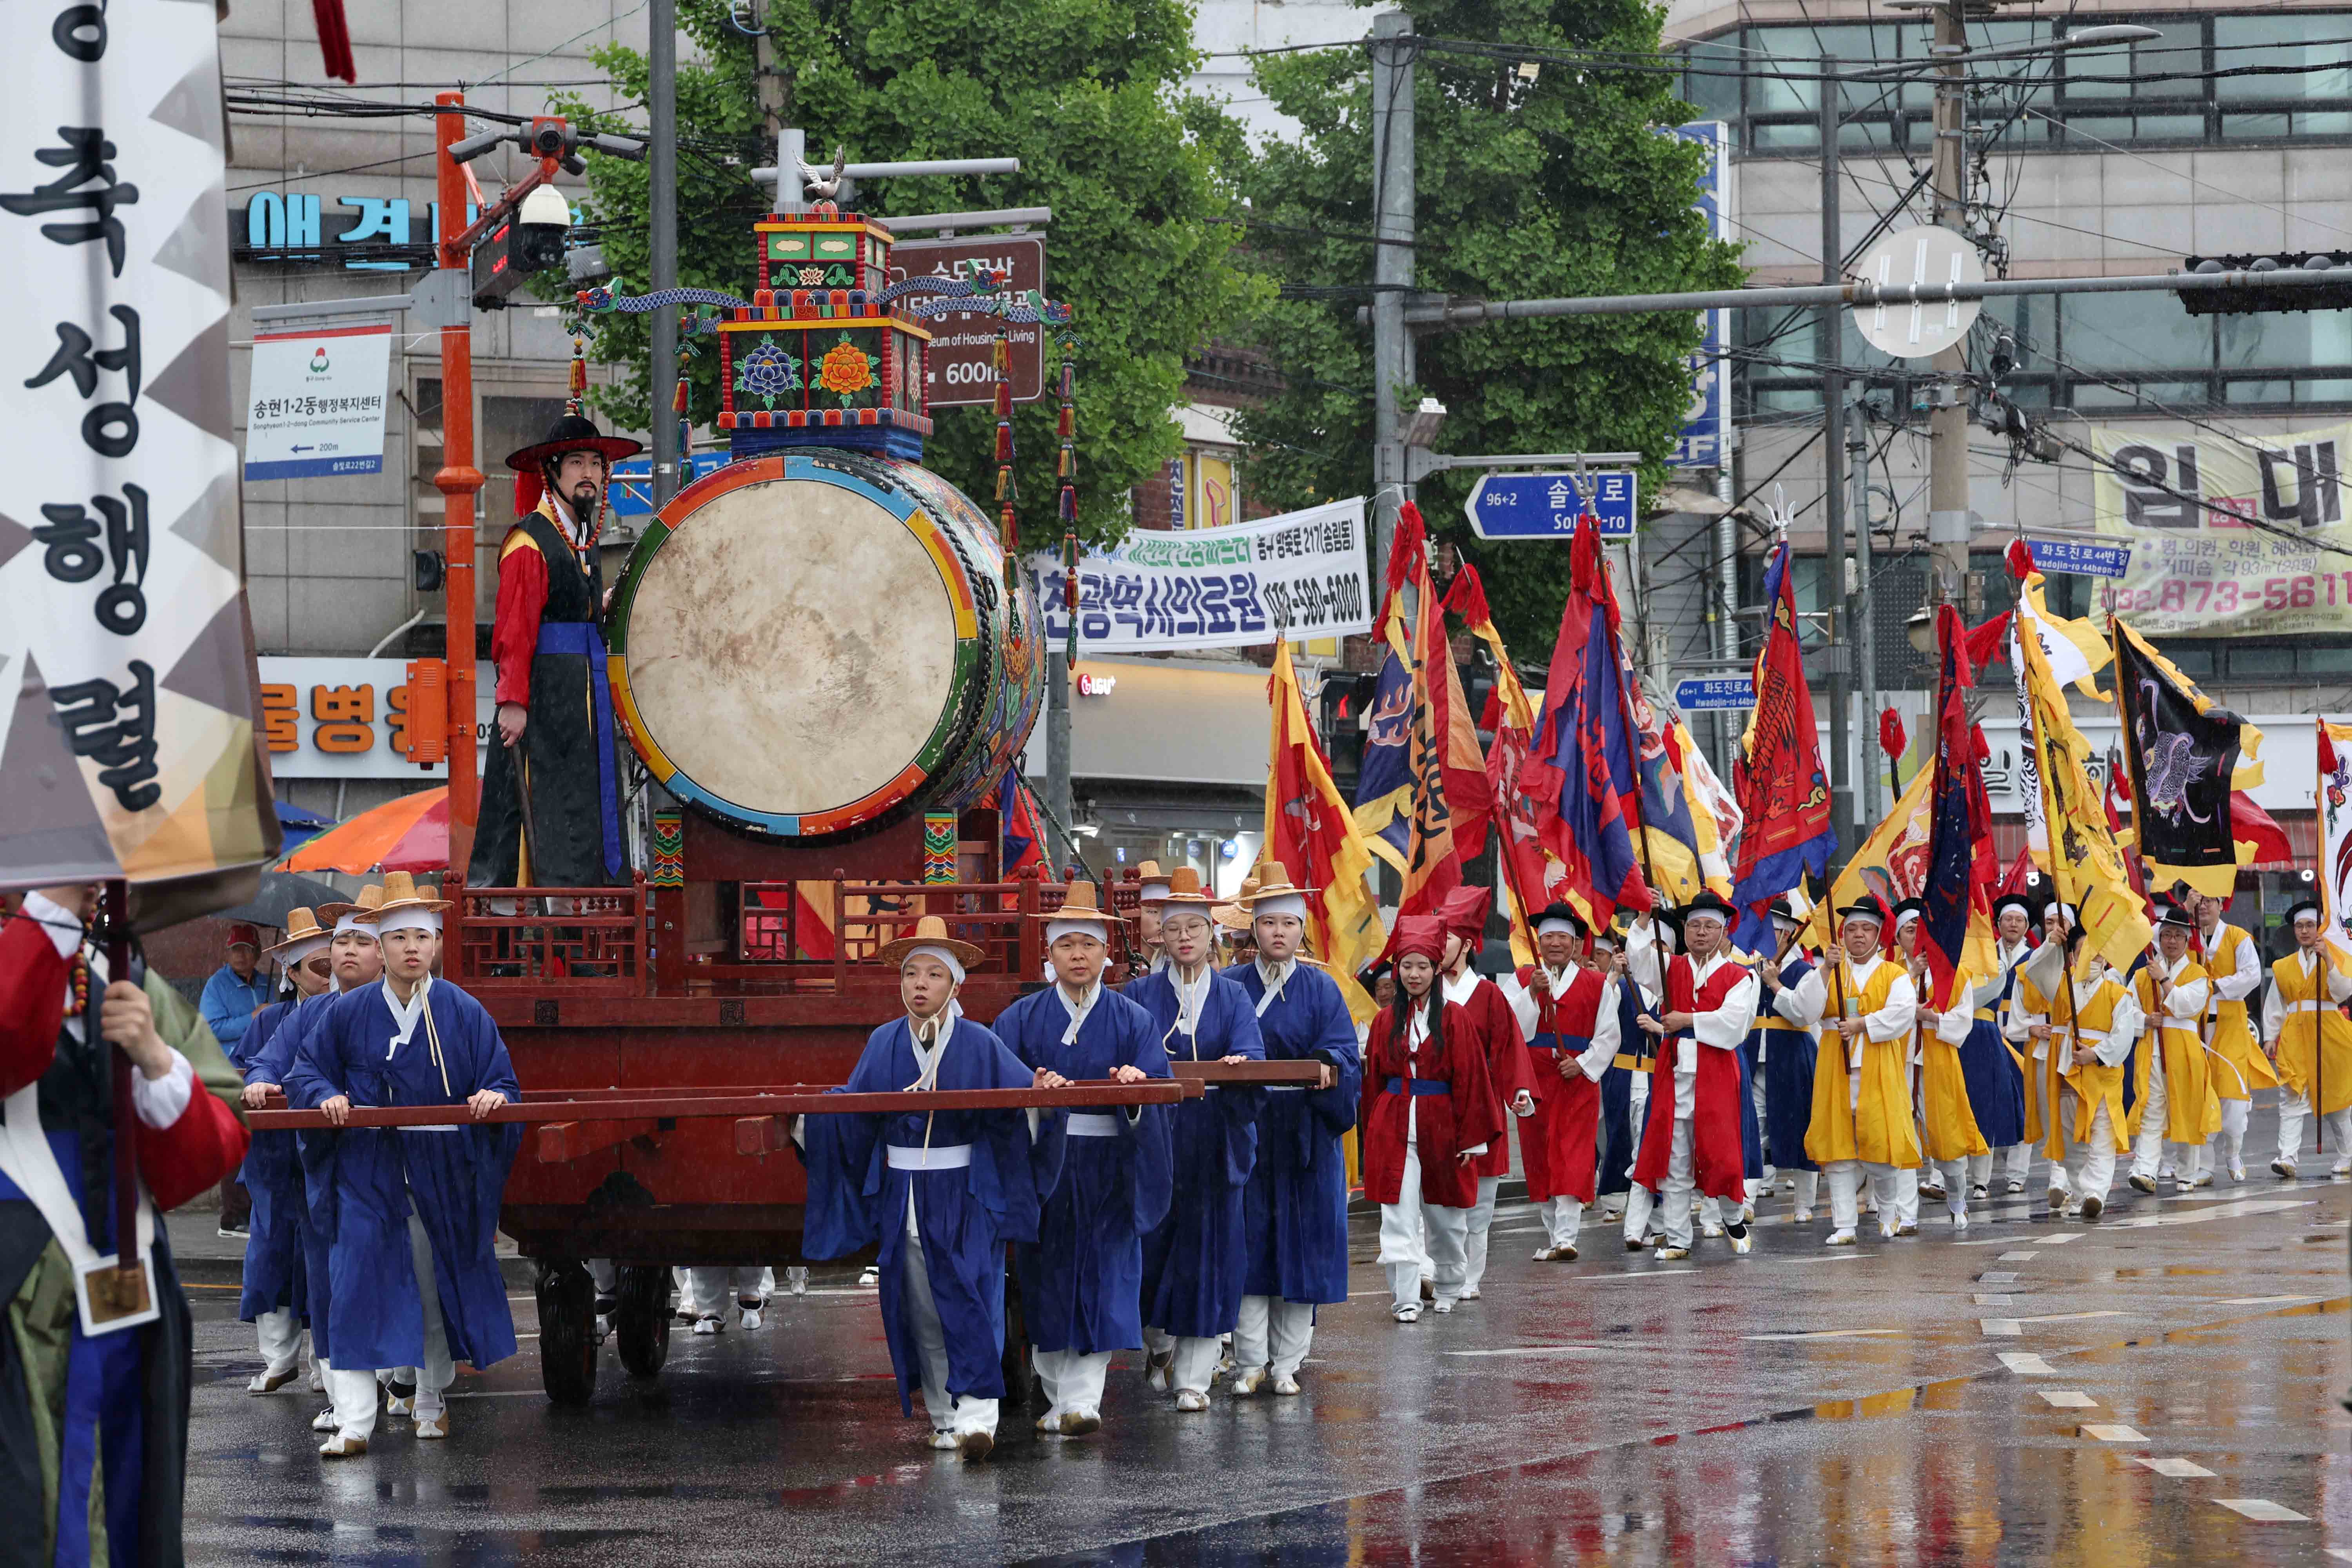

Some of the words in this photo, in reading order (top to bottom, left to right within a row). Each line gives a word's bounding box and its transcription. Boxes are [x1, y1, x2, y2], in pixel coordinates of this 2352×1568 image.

[951, 333, 962, 345] of
[1008, 330, 1035, 343] Living
[309, 418, 338, 426] Community
[319, 443, 339, 452] 200m
[2033, 559, 2080, 571] wadojin-ro
[1263, 572, 1362, 629] 032-580-6000
